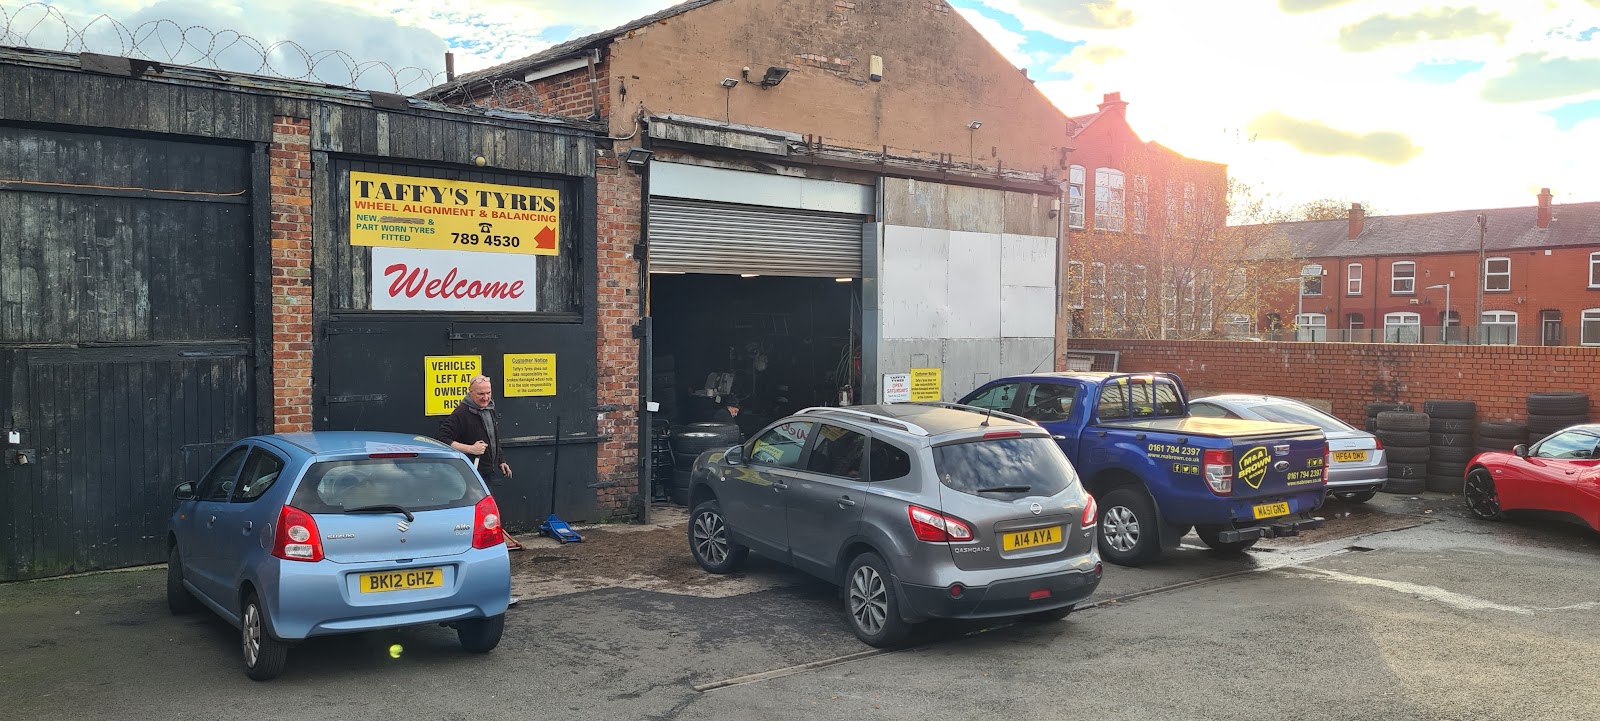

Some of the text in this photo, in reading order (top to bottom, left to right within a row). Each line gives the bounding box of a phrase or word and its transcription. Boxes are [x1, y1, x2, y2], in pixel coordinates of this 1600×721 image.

[355, 180, 556, 213] TAFFY'S TYRES
[354, 201, 557, 223] WHEEL ALIGNMENT & BALANCING
[356, 223, 436, 235] PART WORN TYRES
[381, 233, 411, 242] FITTED
[451, 232, 520, 248] 789 4530
[384, 263, 525, 300] Welcome
[431, 361, 476, 371] VEHICLES
[436, 374, 472, 384] LEFT AT
[434, 386, 470, 396] OWNER
[444, 400, 462, 409] RIS
[1148, 444, 1200, 456] 0161 794 2397
[1335, 452, 1352, 460] HF64
[1148, 452, 1200, 462] www.mabrown.co.uk
[1244, 450, 1264, 466] M&A
[1238, 455, 1272, 478] BROWN
[1287, 468, 1322, 480] 0161 794 2397
[1274, 504, 1286, 514] GNS
[1014, 530, 1052, 547] A14 AYA
[370, 572, 434, 590] BK12 GHZ
